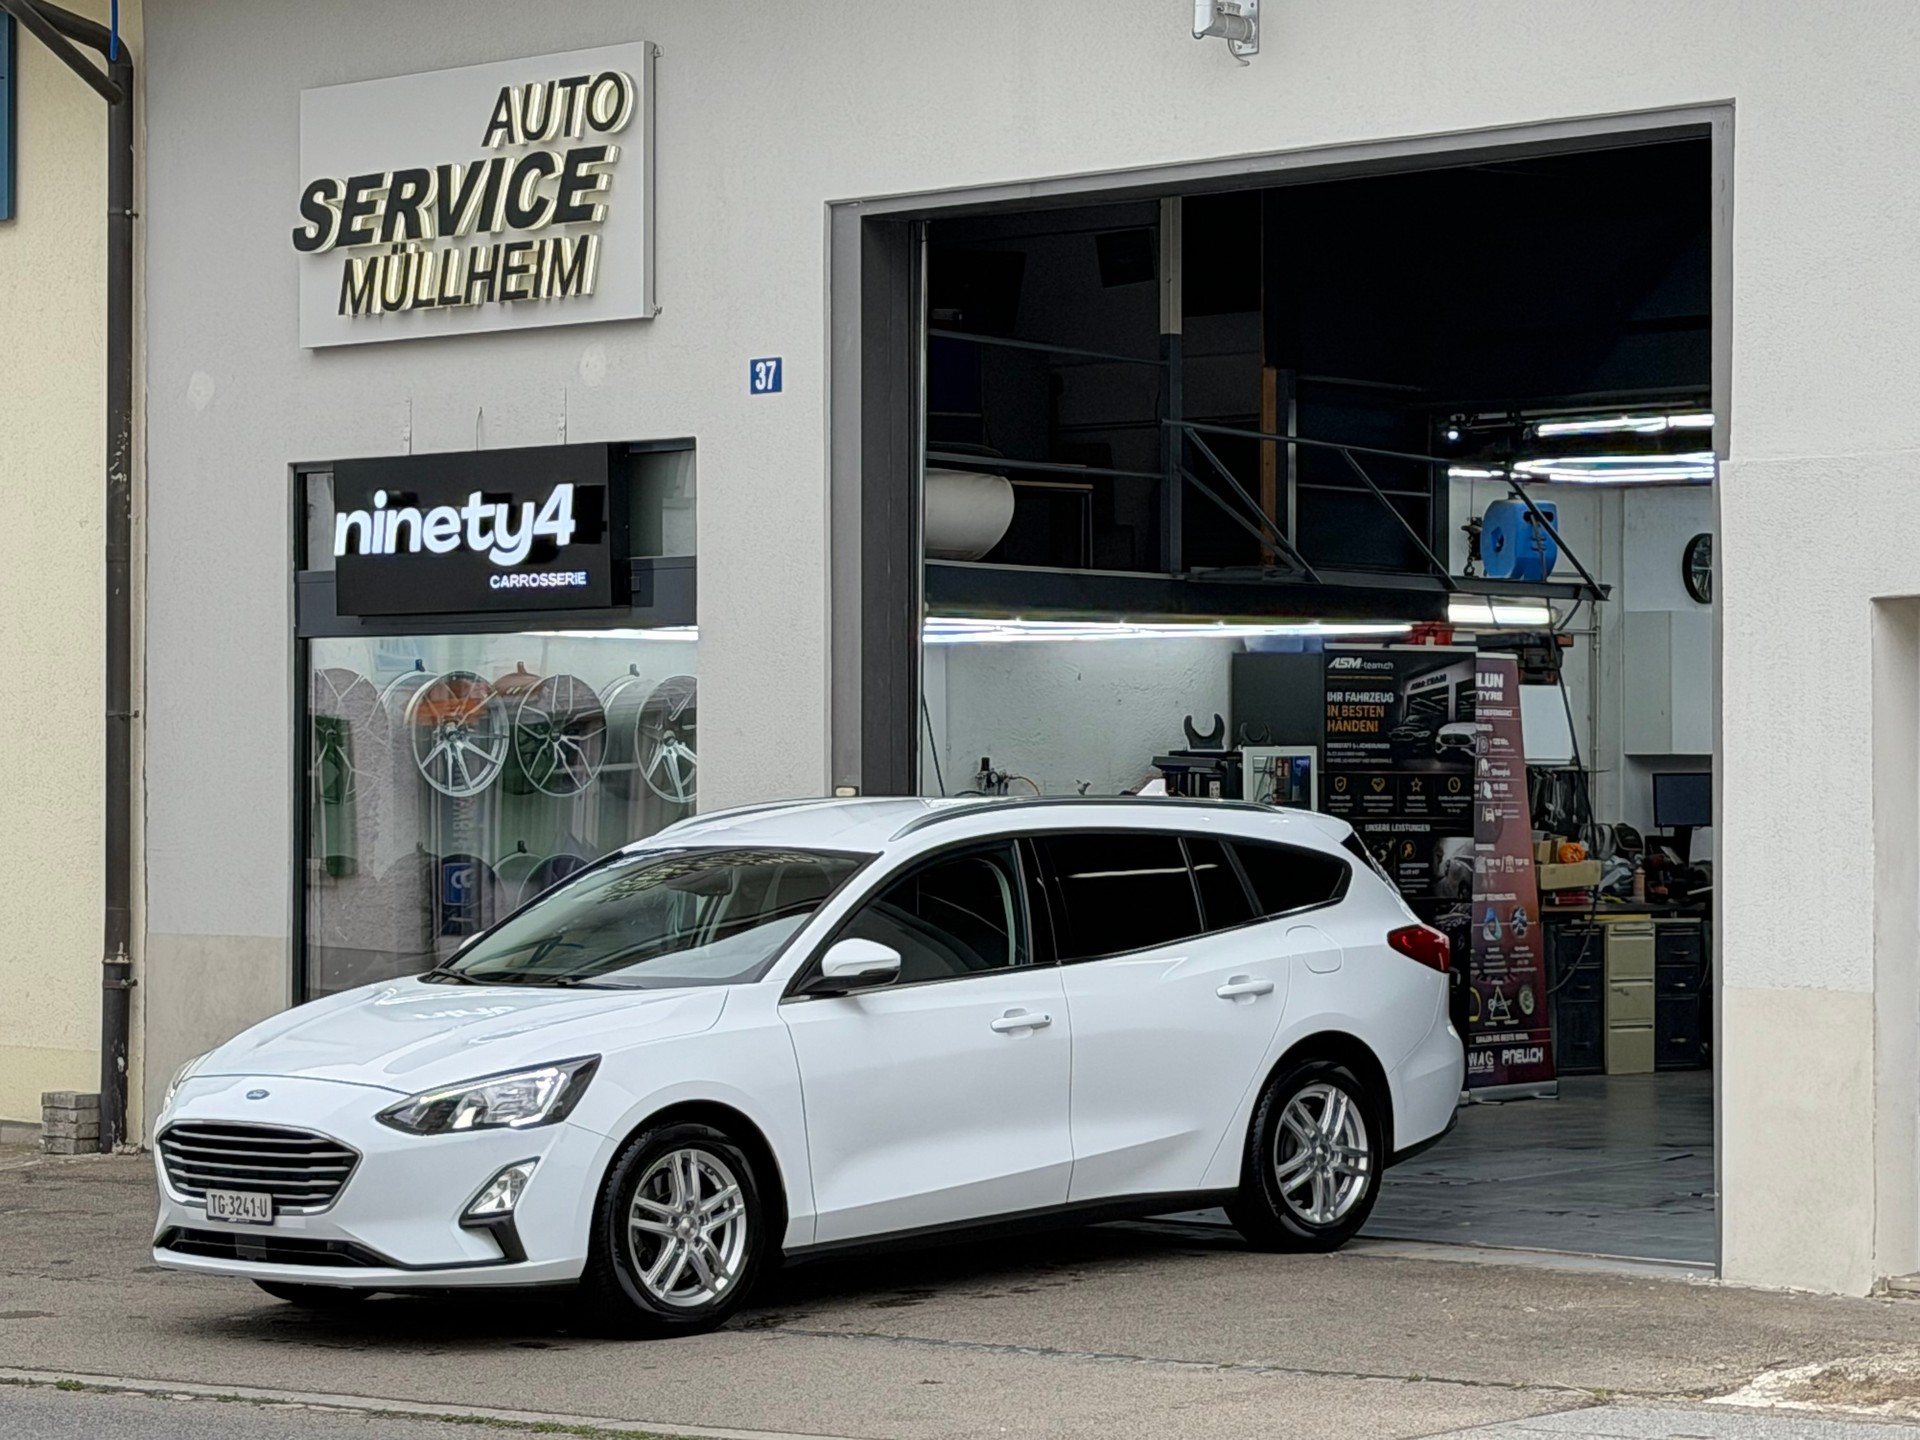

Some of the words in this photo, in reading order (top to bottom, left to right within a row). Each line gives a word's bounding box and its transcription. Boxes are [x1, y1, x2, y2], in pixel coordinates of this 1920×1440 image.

[481, 71, 634, 148] AUTO
[292, 145, 620, 253] SERVICE
[338, 235, 599, 316] MÜLLHEIM
[754, 360, 777, 391] 37
[334, 482, 576, 566] ninety4
[489, 571, 587, 590] CARROSSERIE
[1326, 691, 1344, 702] IHR
[1345, 691, 1395, 703] FAHRZEUG
[1327, 704, 1340, 717] IN
[1341, 704, 1385, 718] BESTEN
